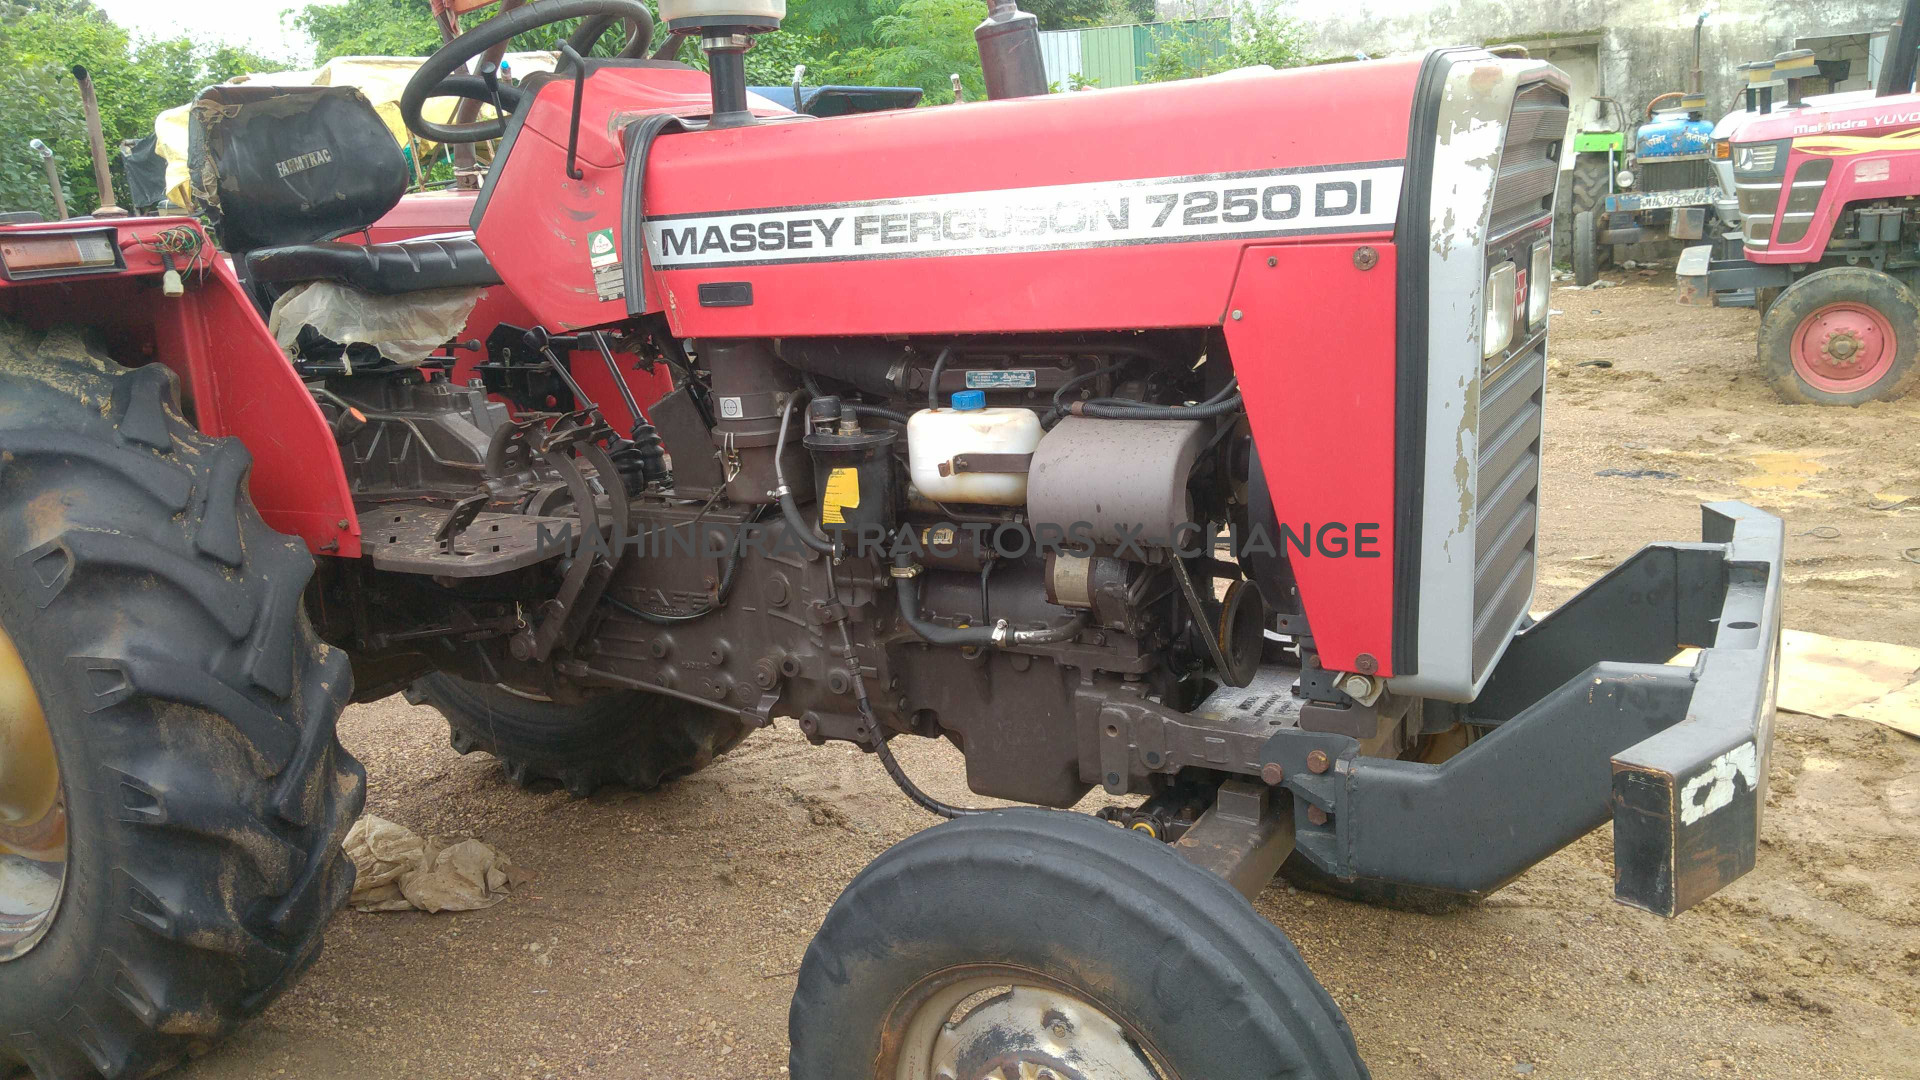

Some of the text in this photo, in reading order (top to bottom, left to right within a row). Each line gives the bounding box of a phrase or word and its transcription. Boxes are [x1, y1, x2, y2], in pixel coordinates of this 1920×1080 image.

[275, 149, 332, 178] FARMTRAC
[661, 179, 1372, 257] MASSEY FERGUSON 7250 DI
